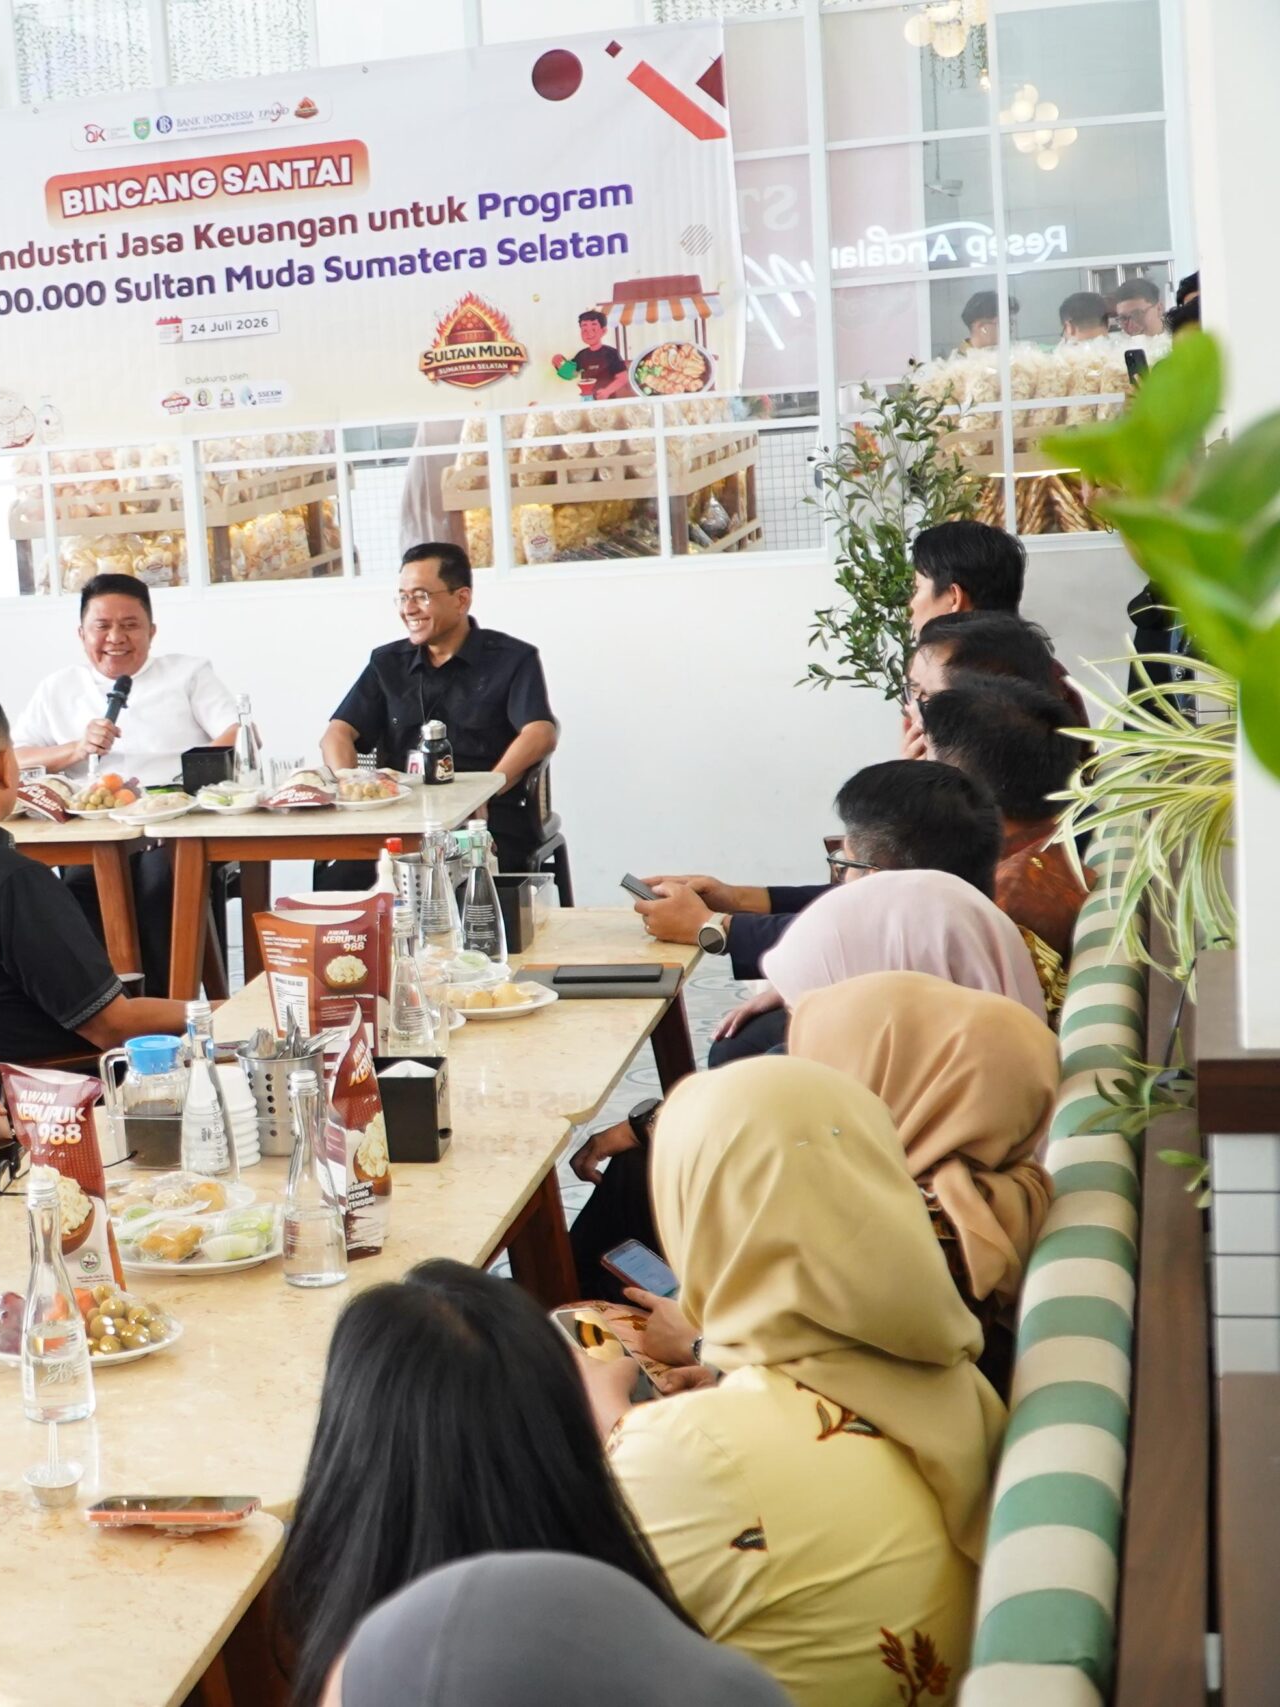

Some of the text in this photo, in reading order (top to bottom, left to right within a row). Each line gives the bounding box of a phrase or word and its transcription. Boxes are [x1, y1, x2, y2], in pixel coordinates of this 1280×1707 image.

[177, 116, 199, 128] BANK
[203, 111, 255, 125] INDONESIA
[61, 154, 354, 218] BINCANG SANTAI
[116, 230, 184, 259] Jasa
[194, 214, 358, 250] Keuangan
[368, 196, 468, 232] untuk
[478, 183, 633, 222] Program
[115, 273, 216, 304] Sultan
[225, 259, 315, 293] Muda
[324, 246, 488, 283] Sumatera
[497, 232, 629, 266] Selatan
[191, 317, 269, 335] 24 Juli 2026
[423, 345, 524, 366] SULTAN MUDA
[437, 362, 509, 375] SUMATERA SELATAN
[184, 373, 227, 386] Didukung
[322, 934, 368, 944] KERUPUK
[343, 942, 365, 952] 988
[20, 1090, 58, 1105] AWAN
[16, 1102, 87, 1124] KERUPUK
[37, 1123, 82, 1145] 988
